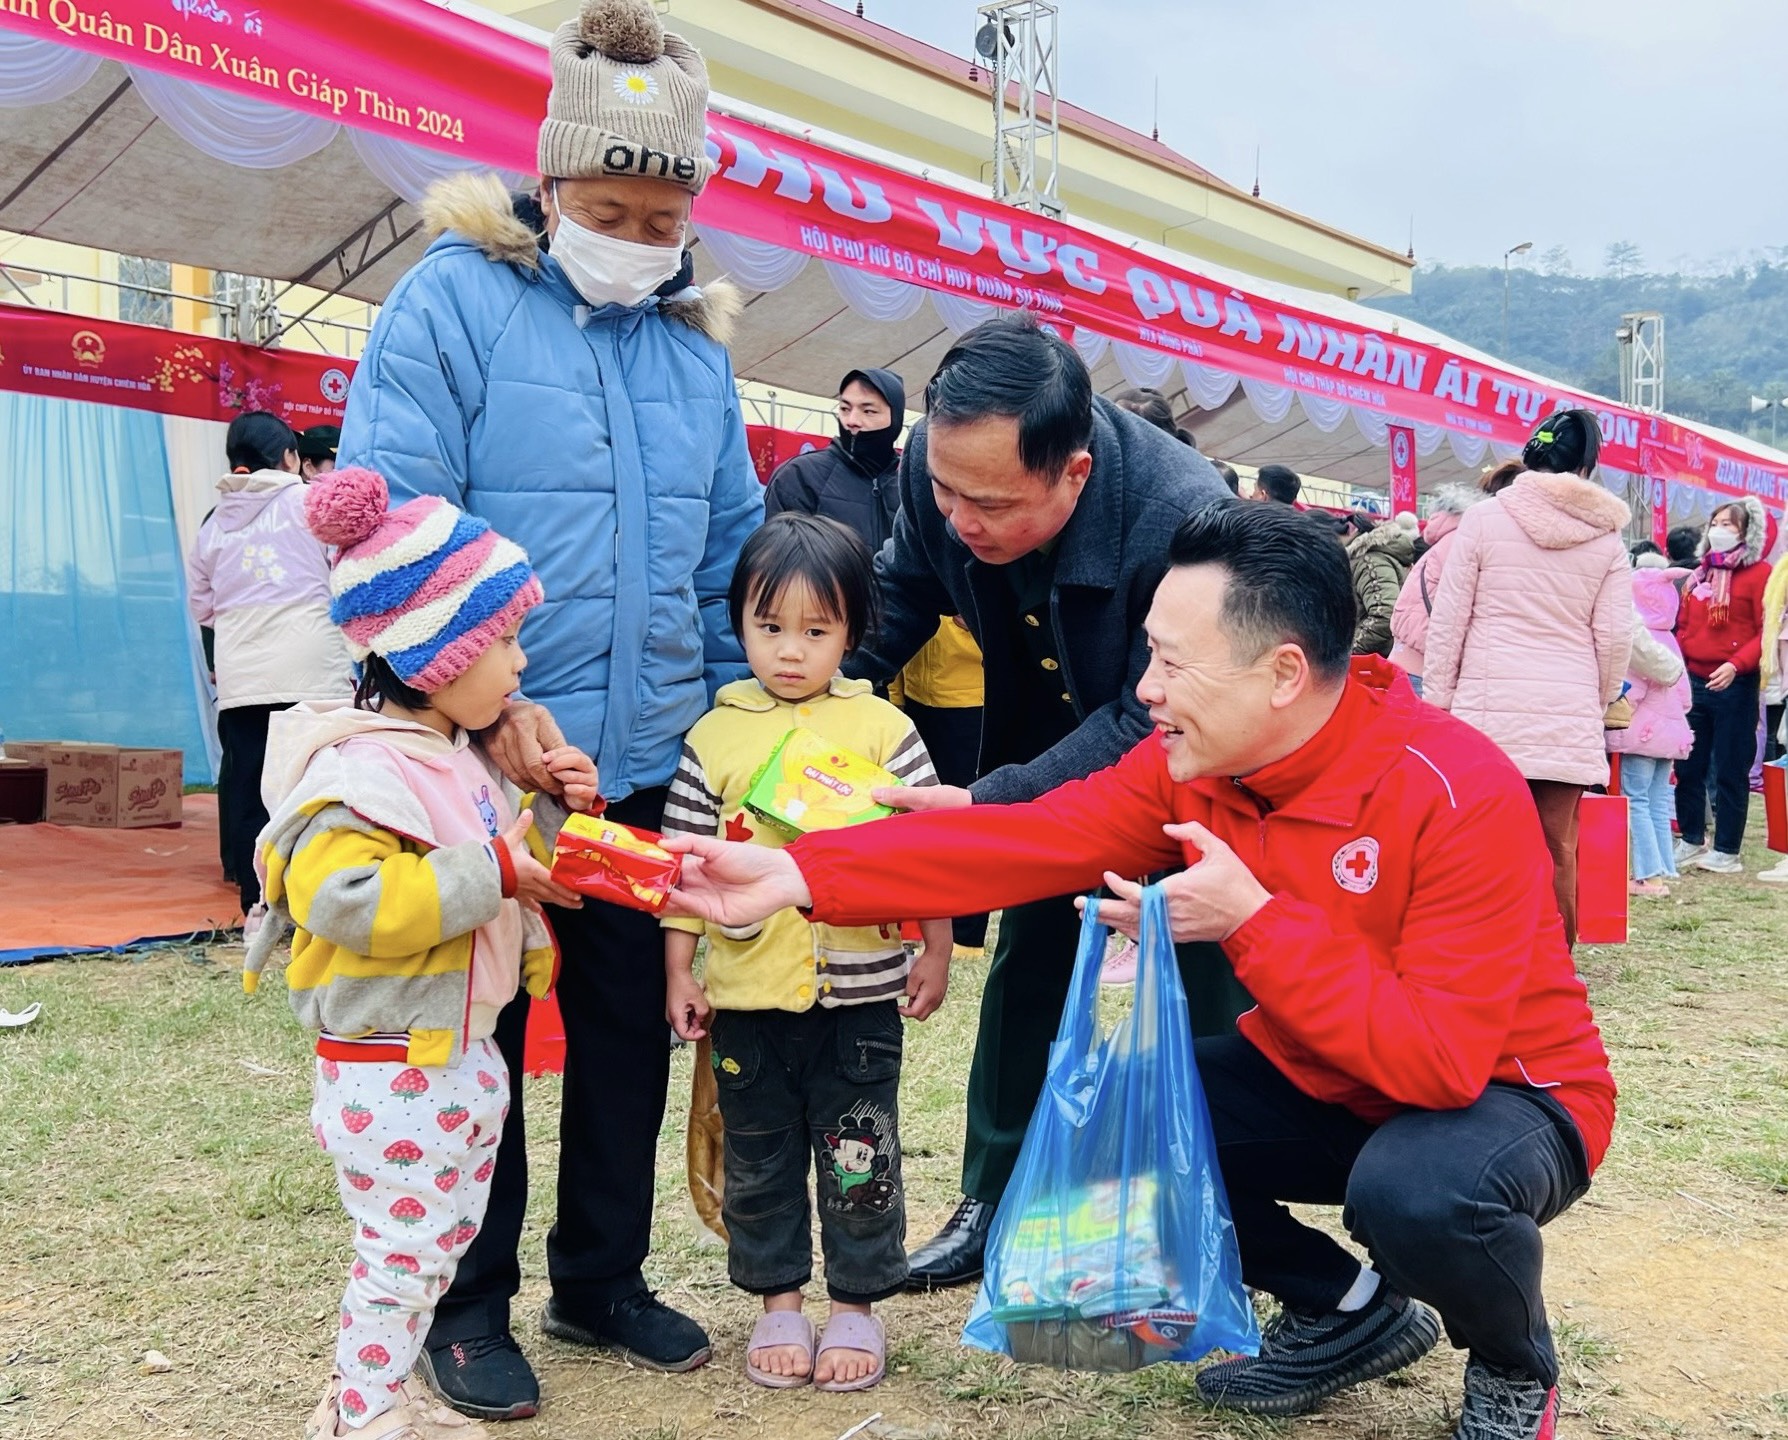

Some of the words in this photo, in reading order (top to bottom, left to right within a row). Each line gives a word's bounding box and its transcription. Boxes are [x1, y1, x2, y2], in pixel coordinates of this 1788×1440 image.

[49, 0, 134, 46] Quân
[144, 22, 203, 66] Dân
[210, 43, 280, 89] Xuân
[287, 67, 349, 115] Giáp
[354, 86, 412, 127] Thìn
[416, 107, 465, 142] 2024
[603, 145, 696, 180] one
[705, 124, 893, 224] HU
[916, 197, 1107, 296] VỰC
[1126, 267, 1264, 345] QUÀ
[1275, 312, 1428, 392] NHÂN
[1433, 358, 1482, 408] ÁI
[1492, 379, 1547, 428] TỰ
[800, 225, 829, 254] HỘI
[832, 235, 865, 265] PHỤ
[869, 243, 890, 268] NỮ
[893, 251, 914, 278] BỘ
[917, 257, 942, 283] CHỈ
[945, 266, 973, 291] HUY
[976, 275, 1013, 301] QUÂN
